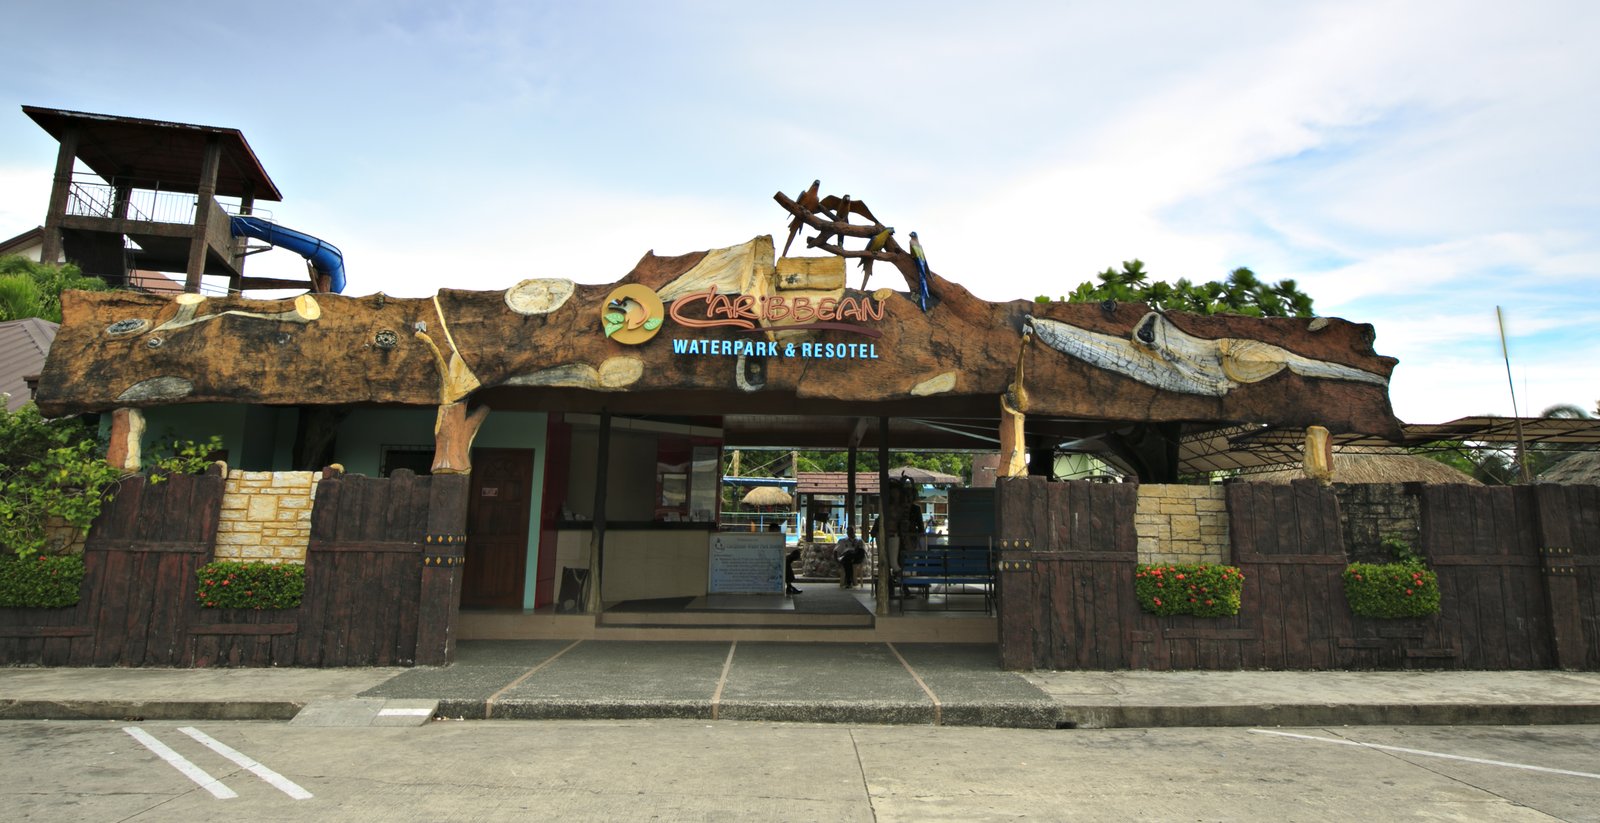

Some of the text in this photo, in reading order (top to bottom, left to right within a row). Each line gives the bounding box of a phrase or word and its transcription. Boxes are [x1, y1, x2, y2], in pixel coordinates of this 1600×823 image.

[673, 339, 879, 359] WATERPARK & RESOTEL
